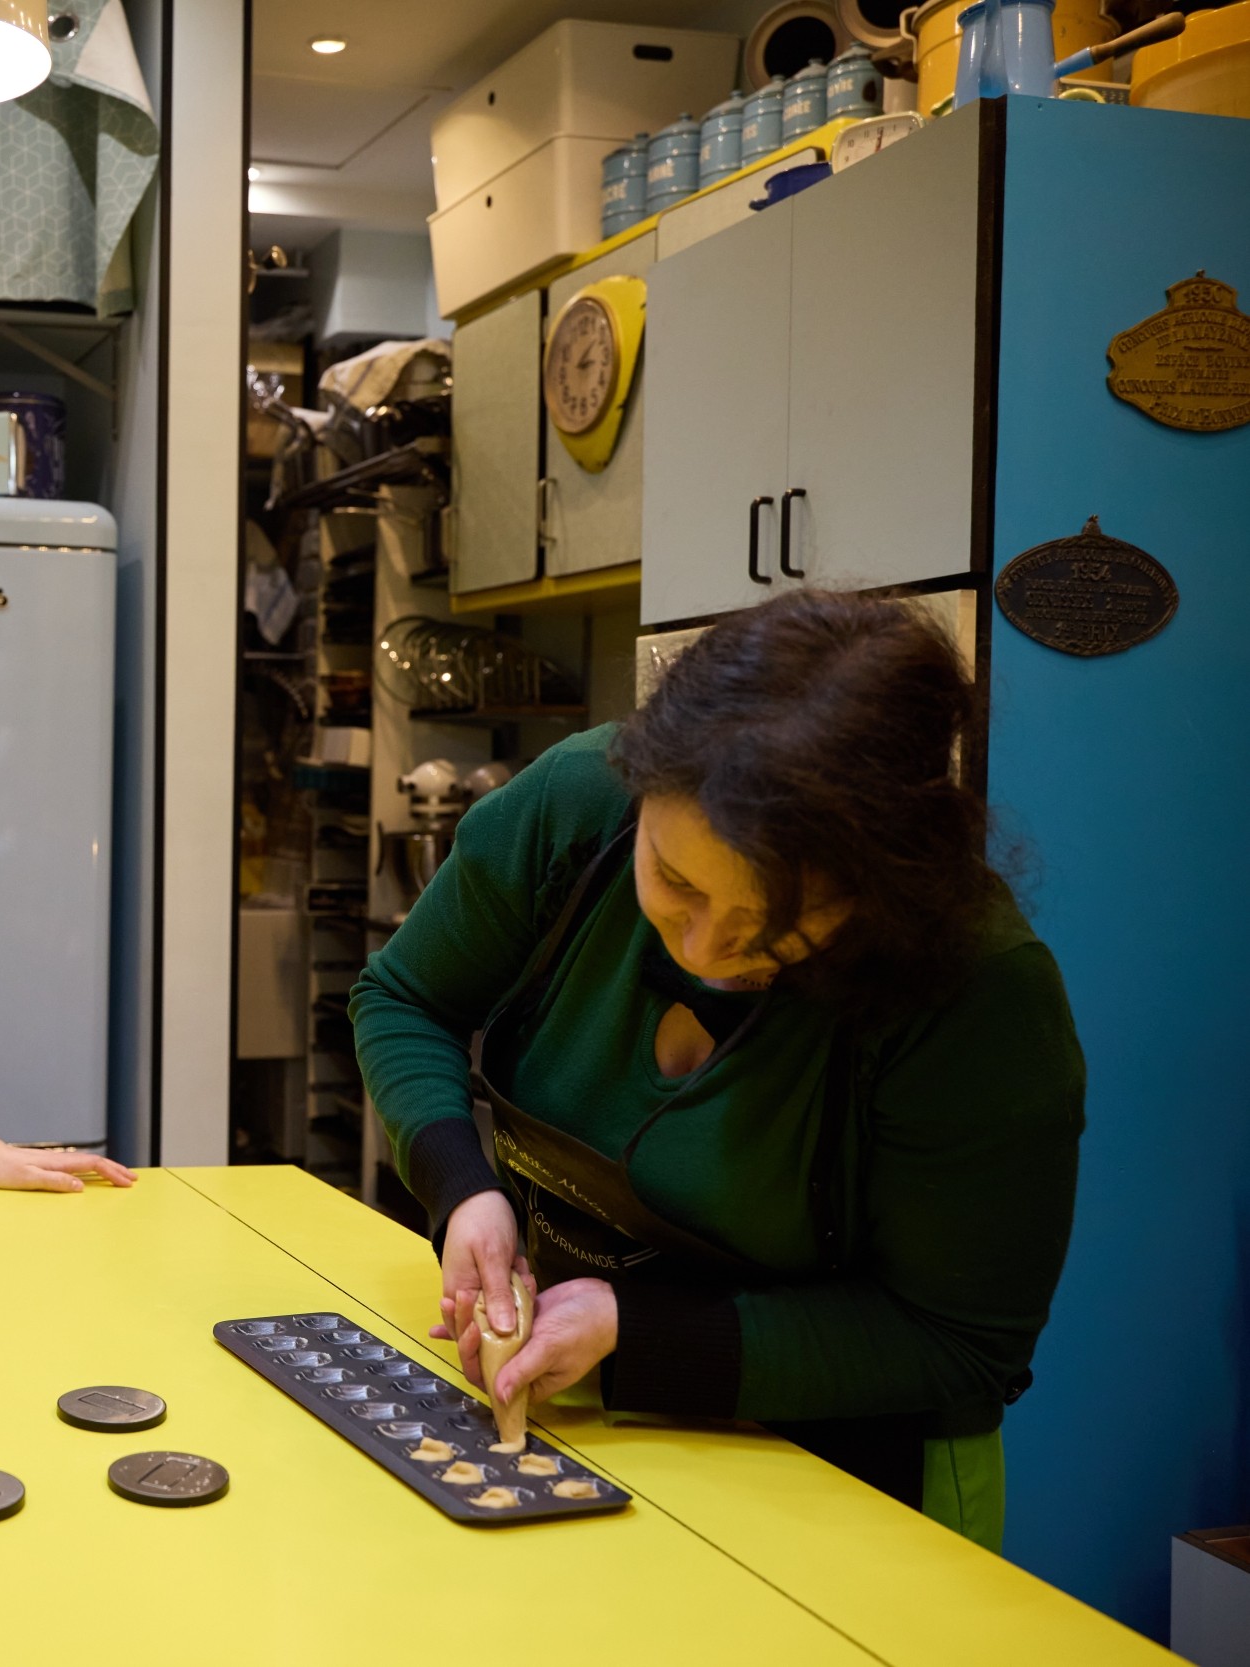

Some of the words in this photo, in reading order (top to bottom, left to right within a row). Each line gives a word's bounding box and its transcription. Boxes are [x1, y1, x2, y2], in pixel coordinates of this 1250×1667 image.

[1183, 284, 1223, 304] 1950
[1117, 379, 1177, 395] CONCOURS
[1071, 562, 1112, 581] 1954
[1078, 623, 1123, 641] PRIX
[558, 1178, 611, 1220] Main
[534, 1211, 619, 1269] GOURMANDE
